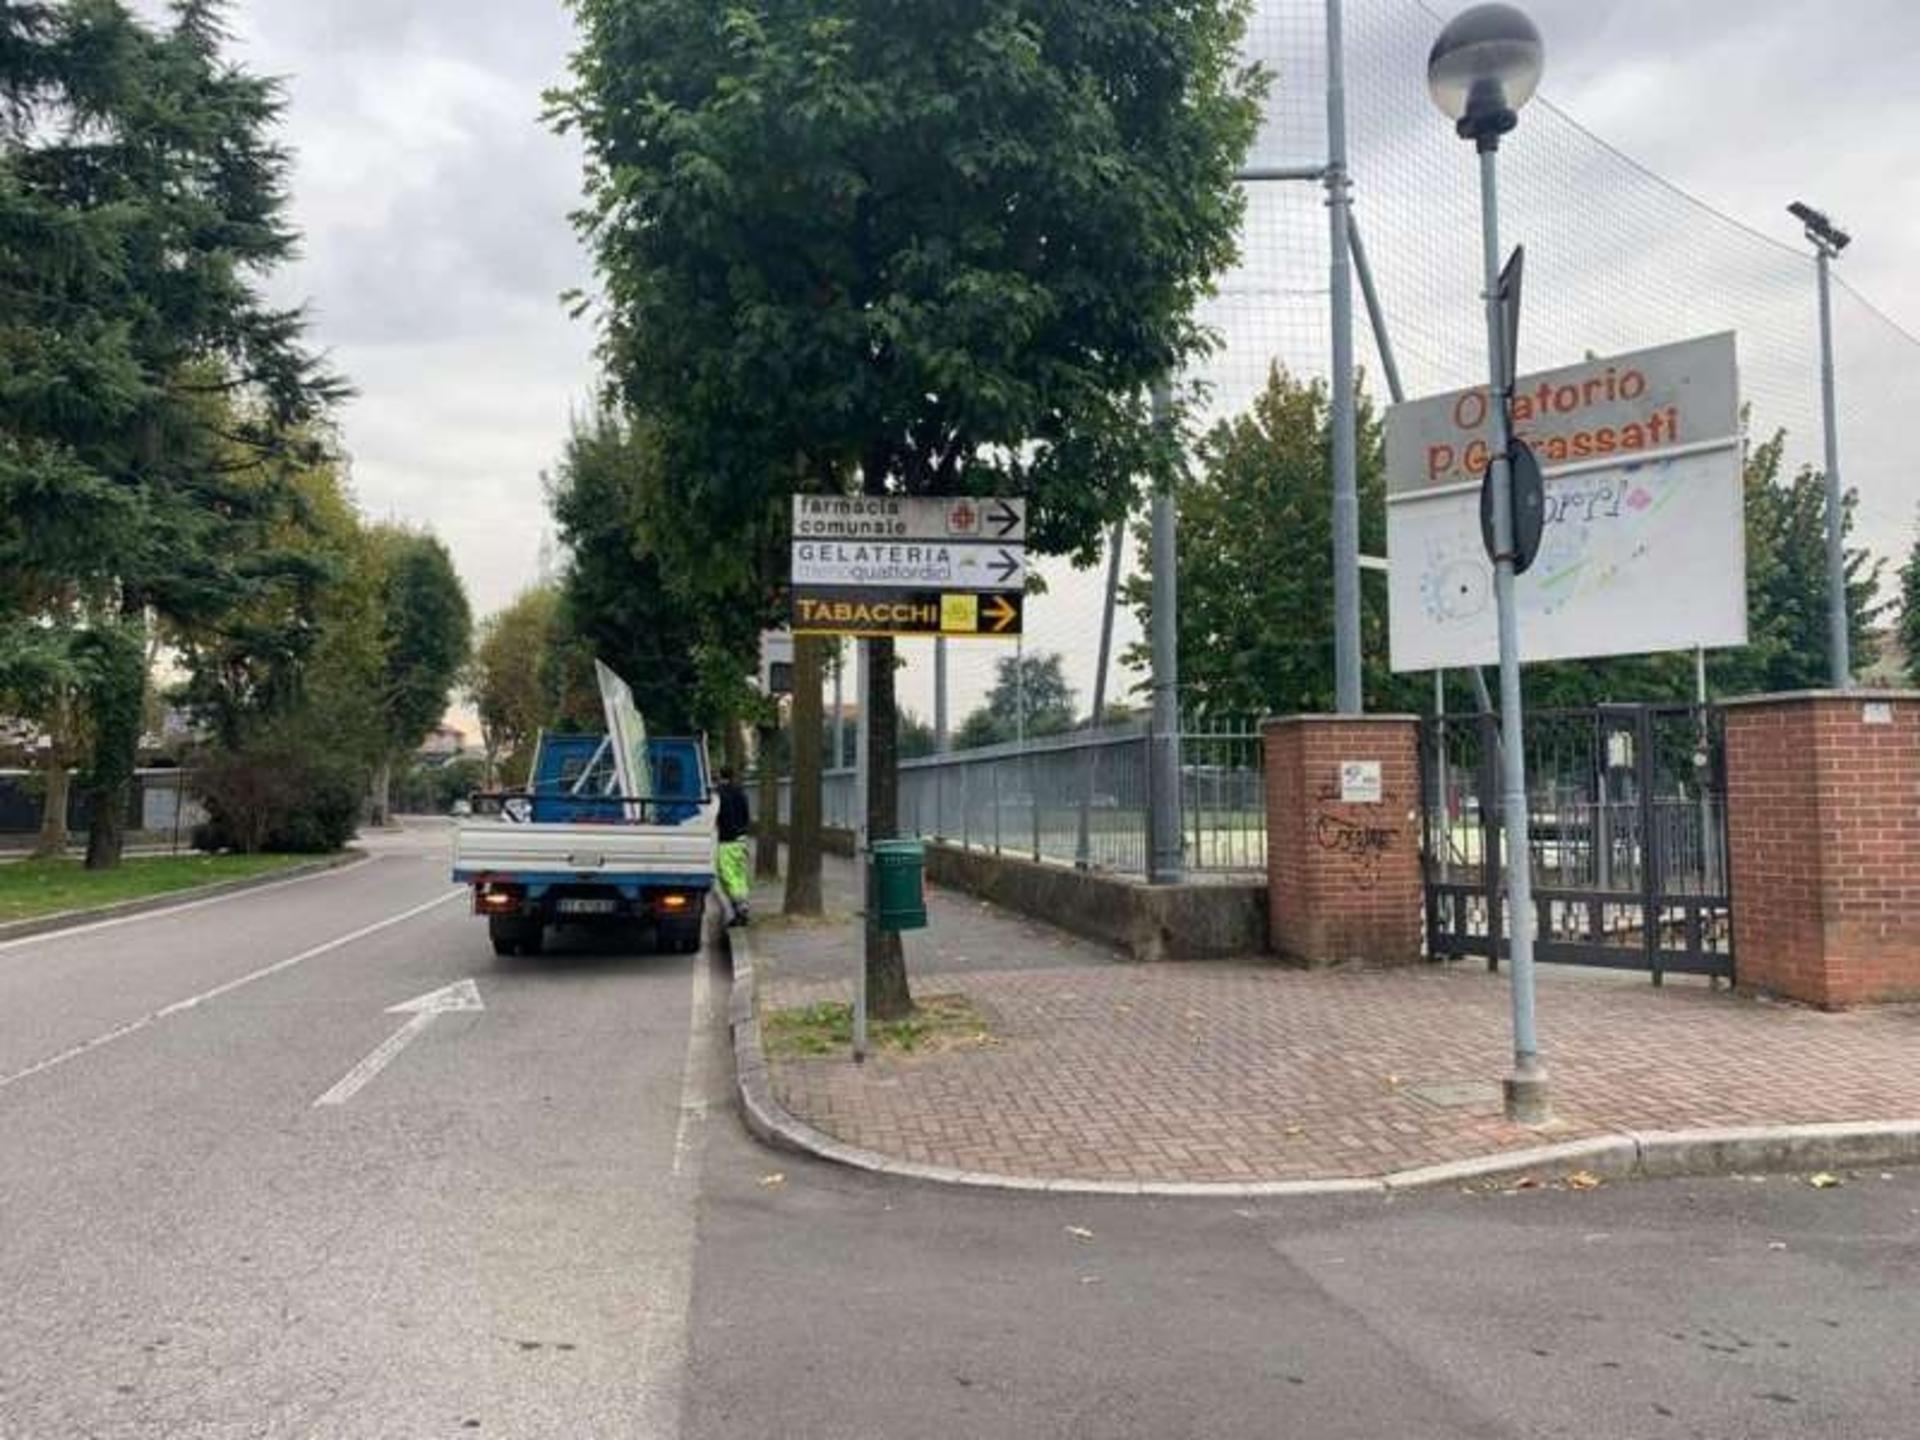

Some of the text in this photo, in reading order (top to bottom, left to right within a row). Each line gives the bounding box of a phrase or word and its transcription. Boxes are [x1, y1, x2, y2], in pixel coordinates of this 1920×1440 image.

[1455, 367, 1645, 429] Oatorio
[800, 520, 907, 535] comunale
[799, 544, 950, 563] GELATERIA
[799, 600, 937, 622] TABACCHI
